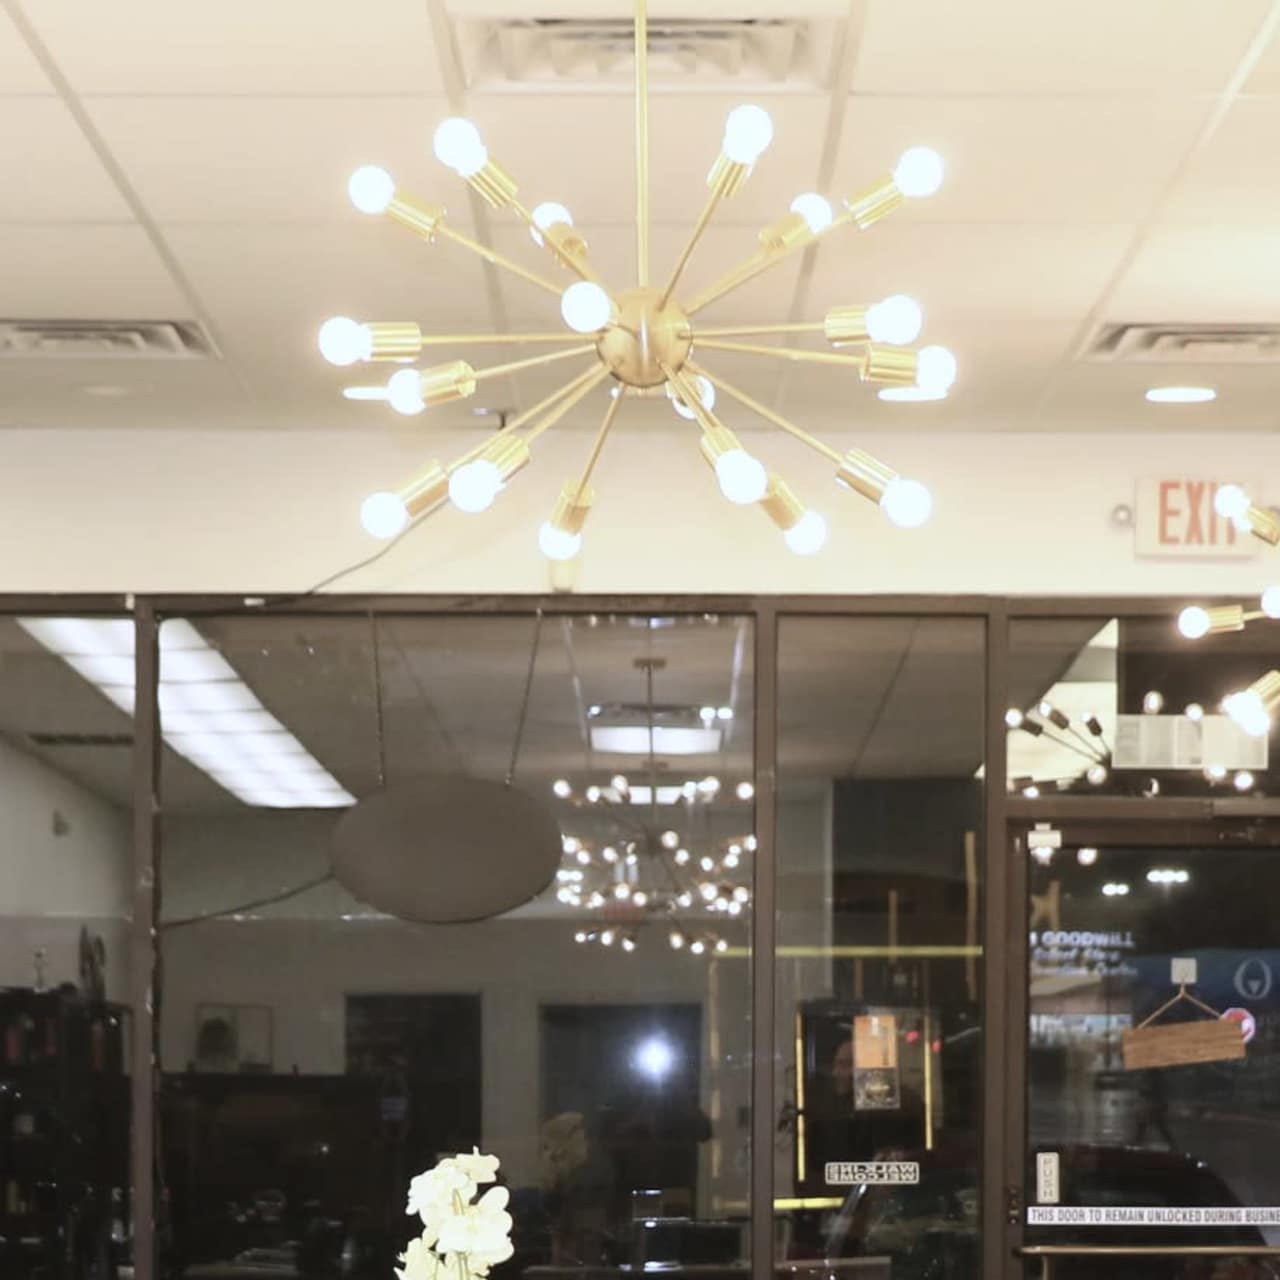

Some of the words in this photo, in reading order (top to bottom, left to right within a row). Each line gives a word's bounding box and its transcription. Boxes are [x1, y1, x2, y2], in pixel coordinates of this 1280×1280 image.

[1032, 1209, 1054, 1222] THIS
[1058, 1209, 1085, 1222] DOOR
[1089, 1209, 1102, 1222] TO
[1105, 1209, 1144, 1222] REMAIN
[1147, 1209, 1202, 1222] UNLOCKED
[1204, 1209, 1242, 1222] DURING
